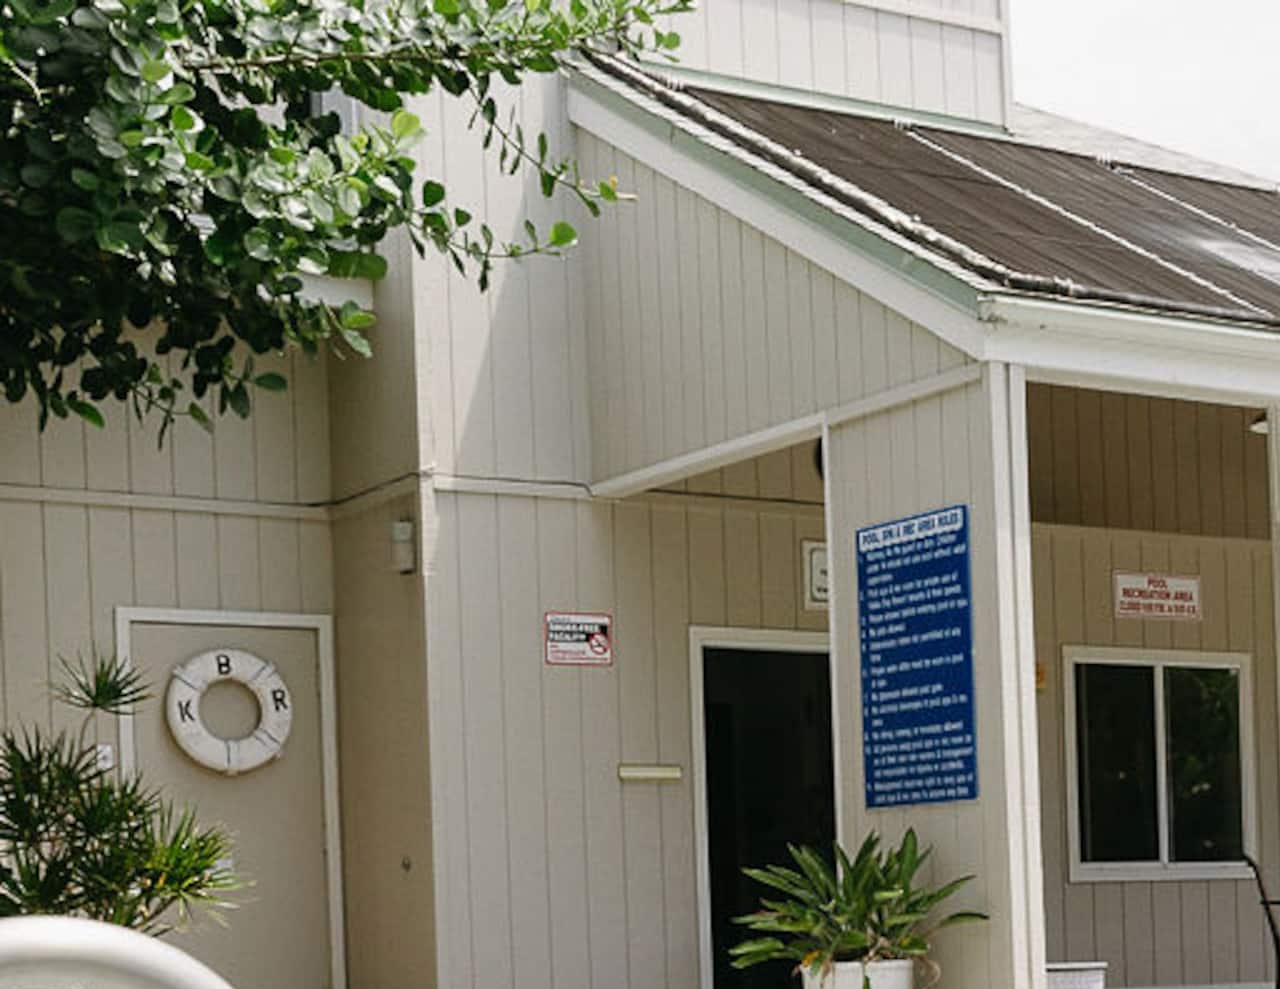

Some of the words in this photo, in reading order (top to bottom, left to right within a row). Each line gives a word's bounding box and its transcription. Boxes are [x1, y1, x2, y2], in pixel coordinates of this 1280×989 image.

[178, 700, 195, 722] K
[216, 654, 231, 675] B
[272, 689, 288, 711] R
